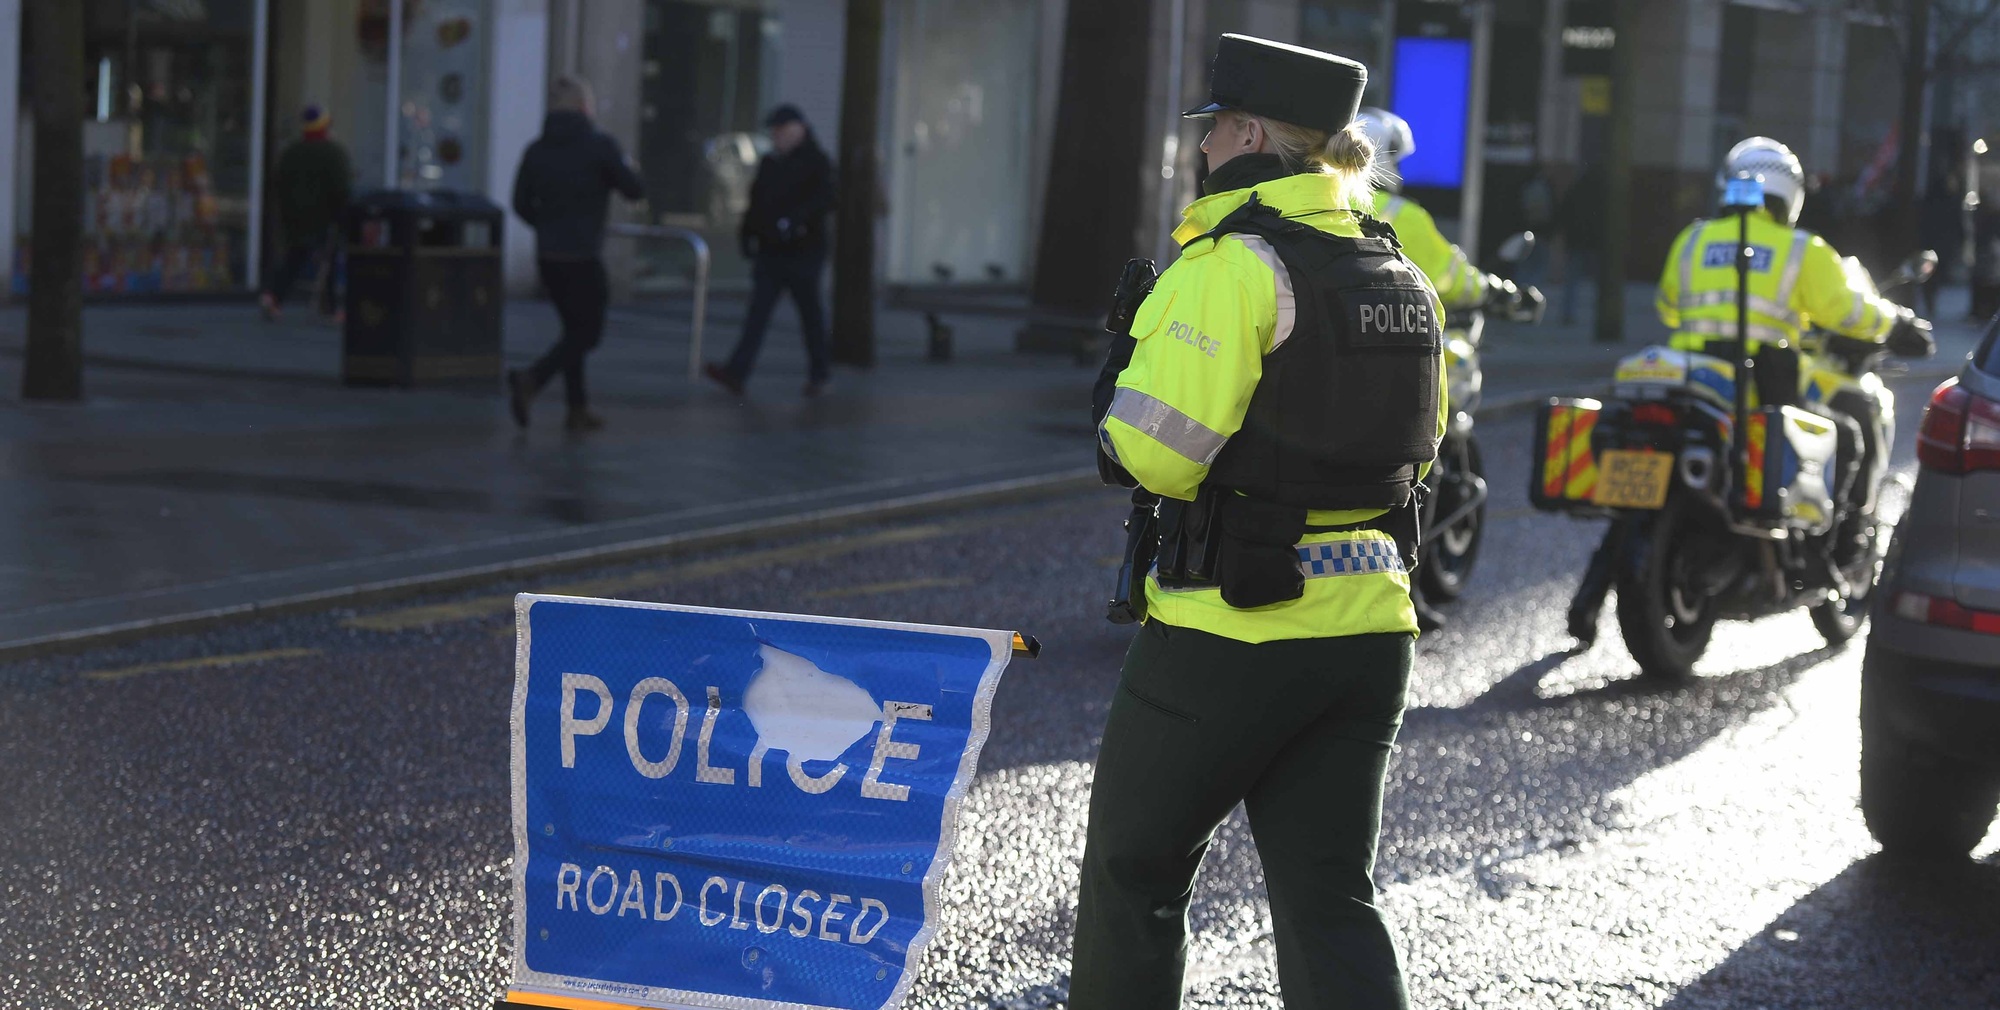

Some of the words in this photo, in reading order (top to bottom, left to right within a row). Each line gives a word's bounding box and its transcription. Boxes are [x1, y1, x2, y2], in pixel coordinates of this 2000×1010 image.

[1706, 245, 1770, 271] POLE
[1359, 303, 1429, 334] POLICE
[1166, 320, 1221, 359] POLICE
[556, 862, 683, 921] ROAD
[699, 876, 889, 944] CLOSED
